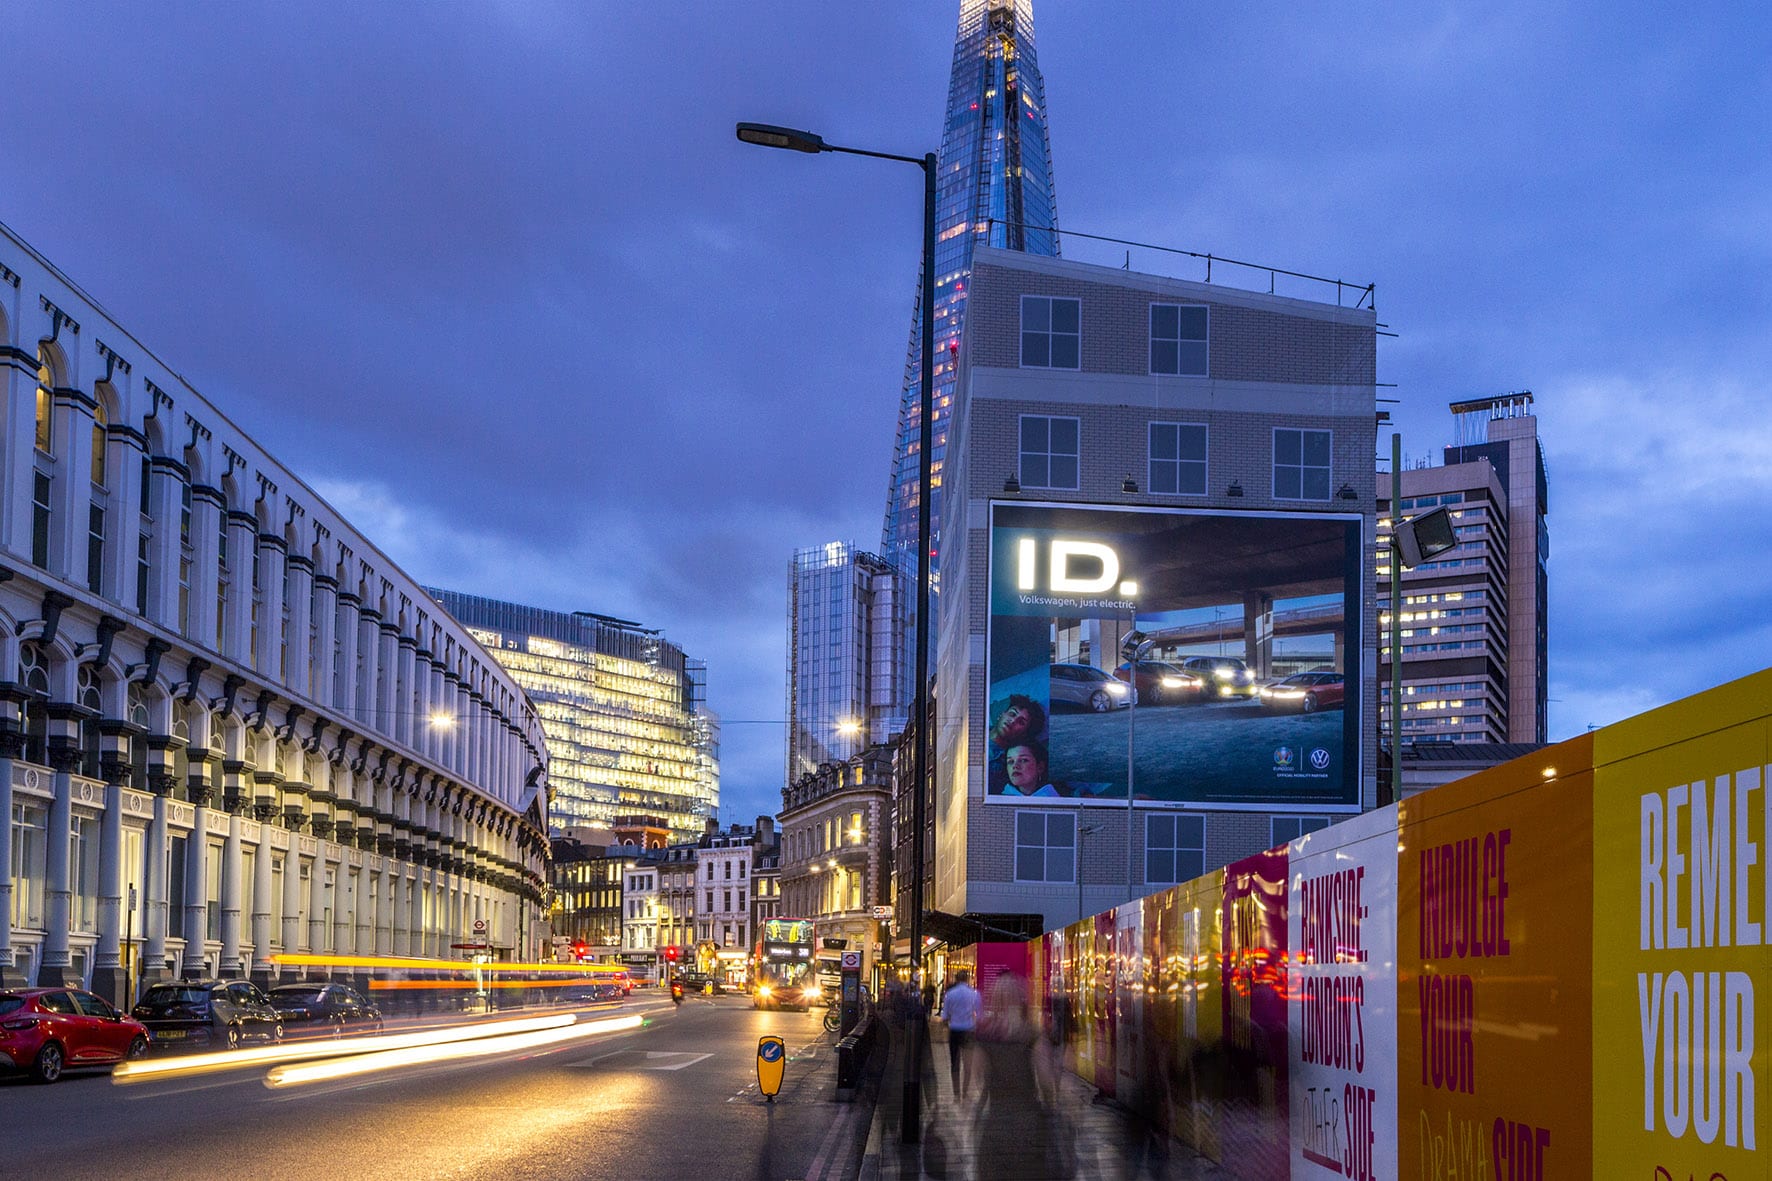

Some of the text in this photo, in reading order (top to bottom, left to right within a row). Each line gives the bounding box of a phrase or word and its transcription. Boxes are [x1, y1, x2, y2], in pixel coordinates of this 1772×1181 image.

[1018, 539, 1137, 595] ID.
[1019, 595, 1136, 609] Volkswagen, just electric.
[1419, 828, 1511, 960] INDULGE
[1640, 763, 1772, 950] REME
[1301, 866, 1369, 965] BANKSIDE:
[1301, 975, 1365, 1074] LONDON'S
[1418, 974, 1475, 1095] YOUR
[1637, 970, 1756, 1151] YOUR
[1344, 1082, 1376, 1181] SIDE
